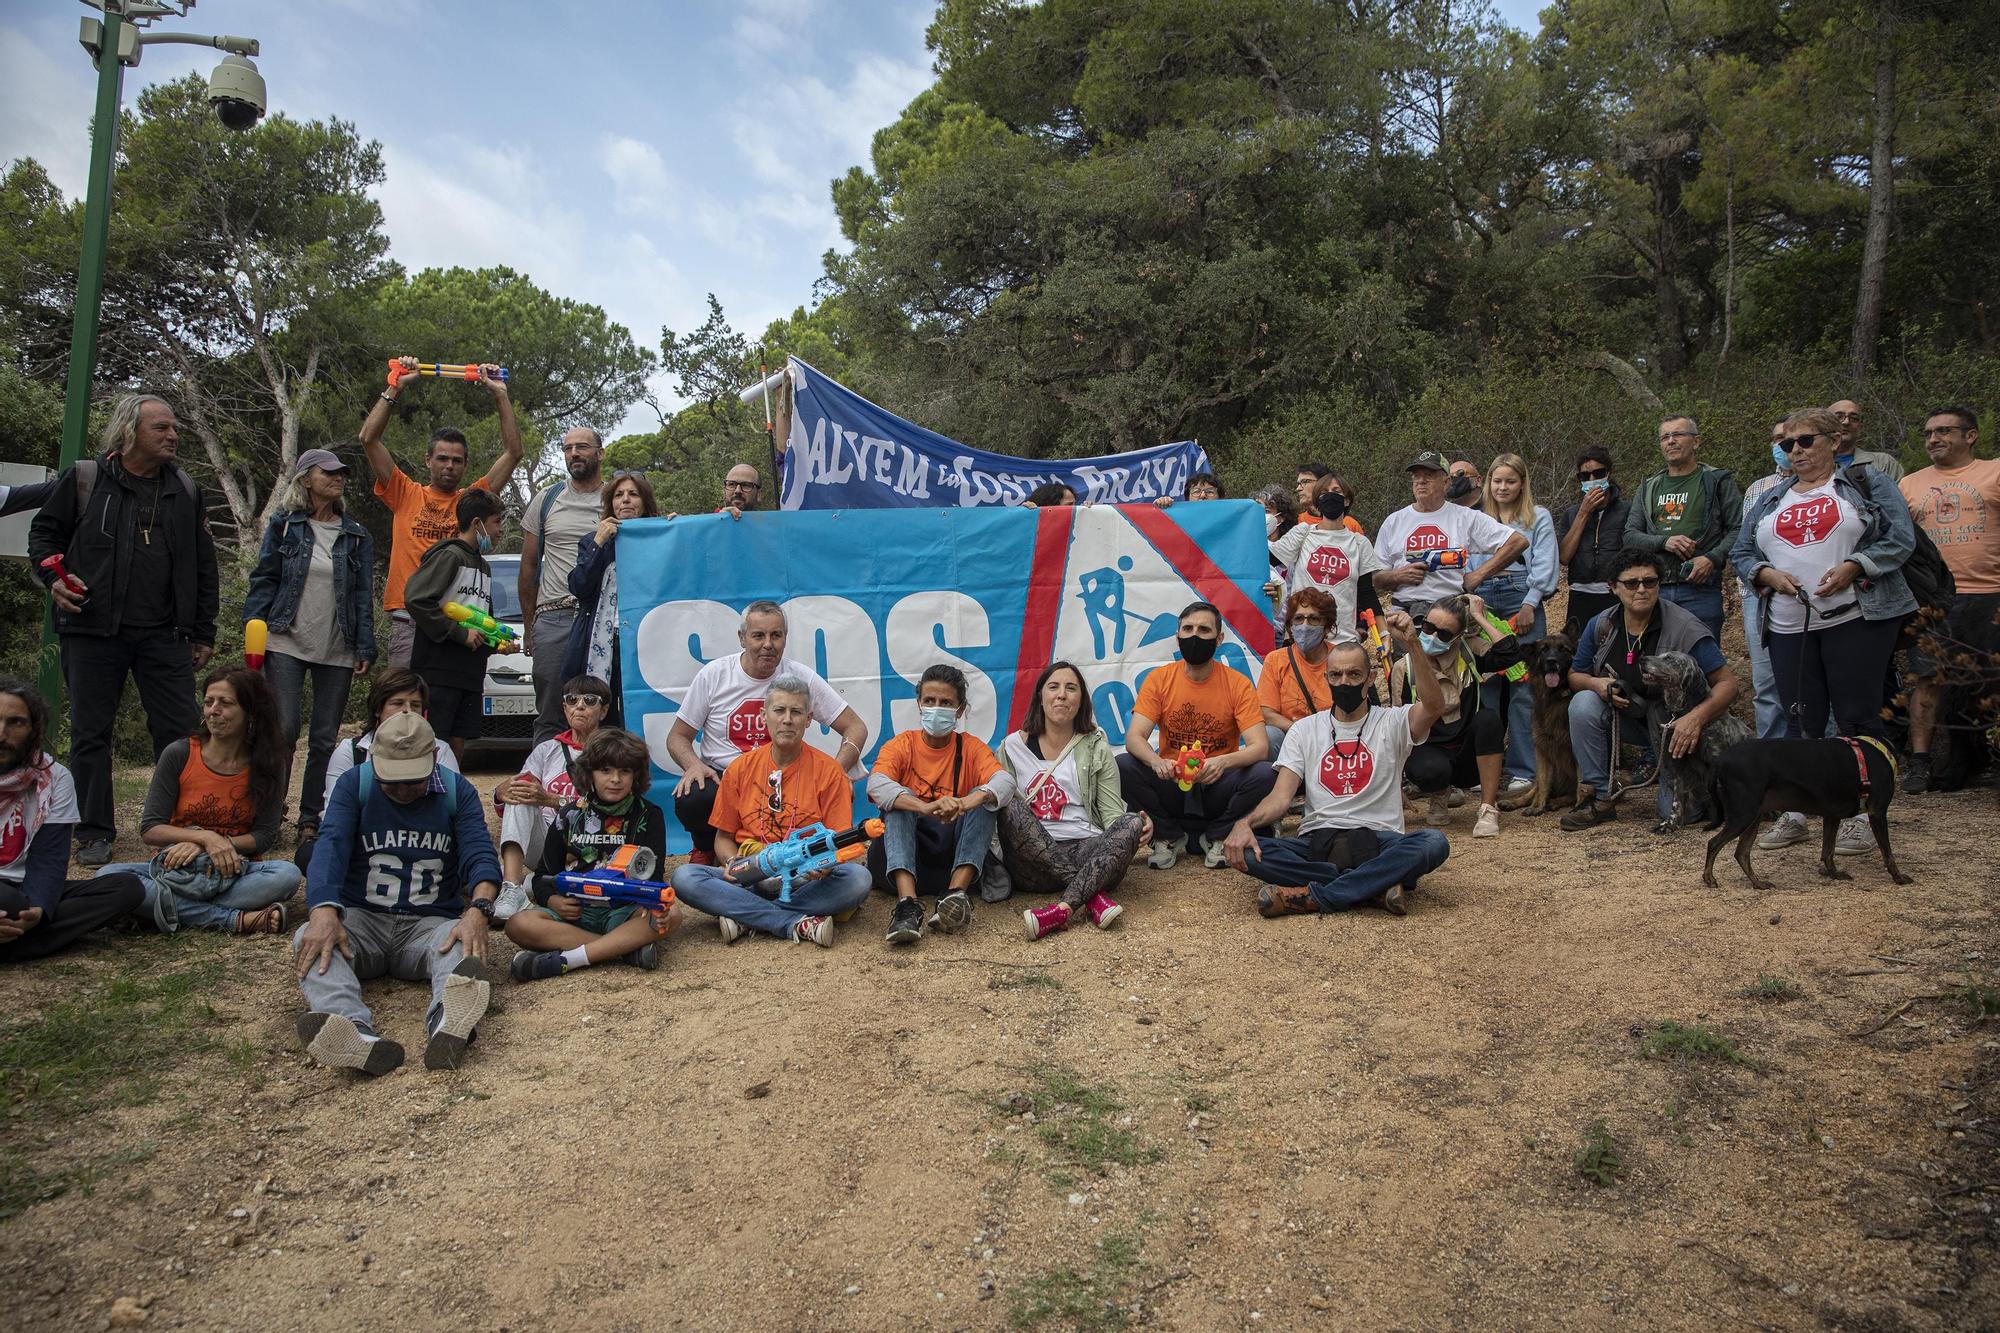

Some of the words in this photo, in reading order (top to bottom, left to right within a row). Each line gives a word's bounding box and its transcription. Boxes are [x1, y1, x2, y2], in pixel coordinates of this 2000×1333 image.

[953, 455, 1064, 508] COST
[1657, 492, 1689, 506] ALERTA!
[1780, 498, 1833, 523] STOP
[1795, 517, 1819, 528] C-32
[1409, 533, 1446, 548] STOP
[1311, 553, 1347, 569] STOP
[1320, 566, 1336, 574] C-32
[636, 590, 997, 776] SOS
[732, 713, 767, 732] STO
[746, 732, 766, 741] C-32
[1323, 751, 1369, 772] STOP
[1337, 771, 1357, 780] C-32
[361, 829, 453, 855] LLAFRANC
[570, 833, 627, 846] MINECRA
[364, 853, 445, 908] 60
